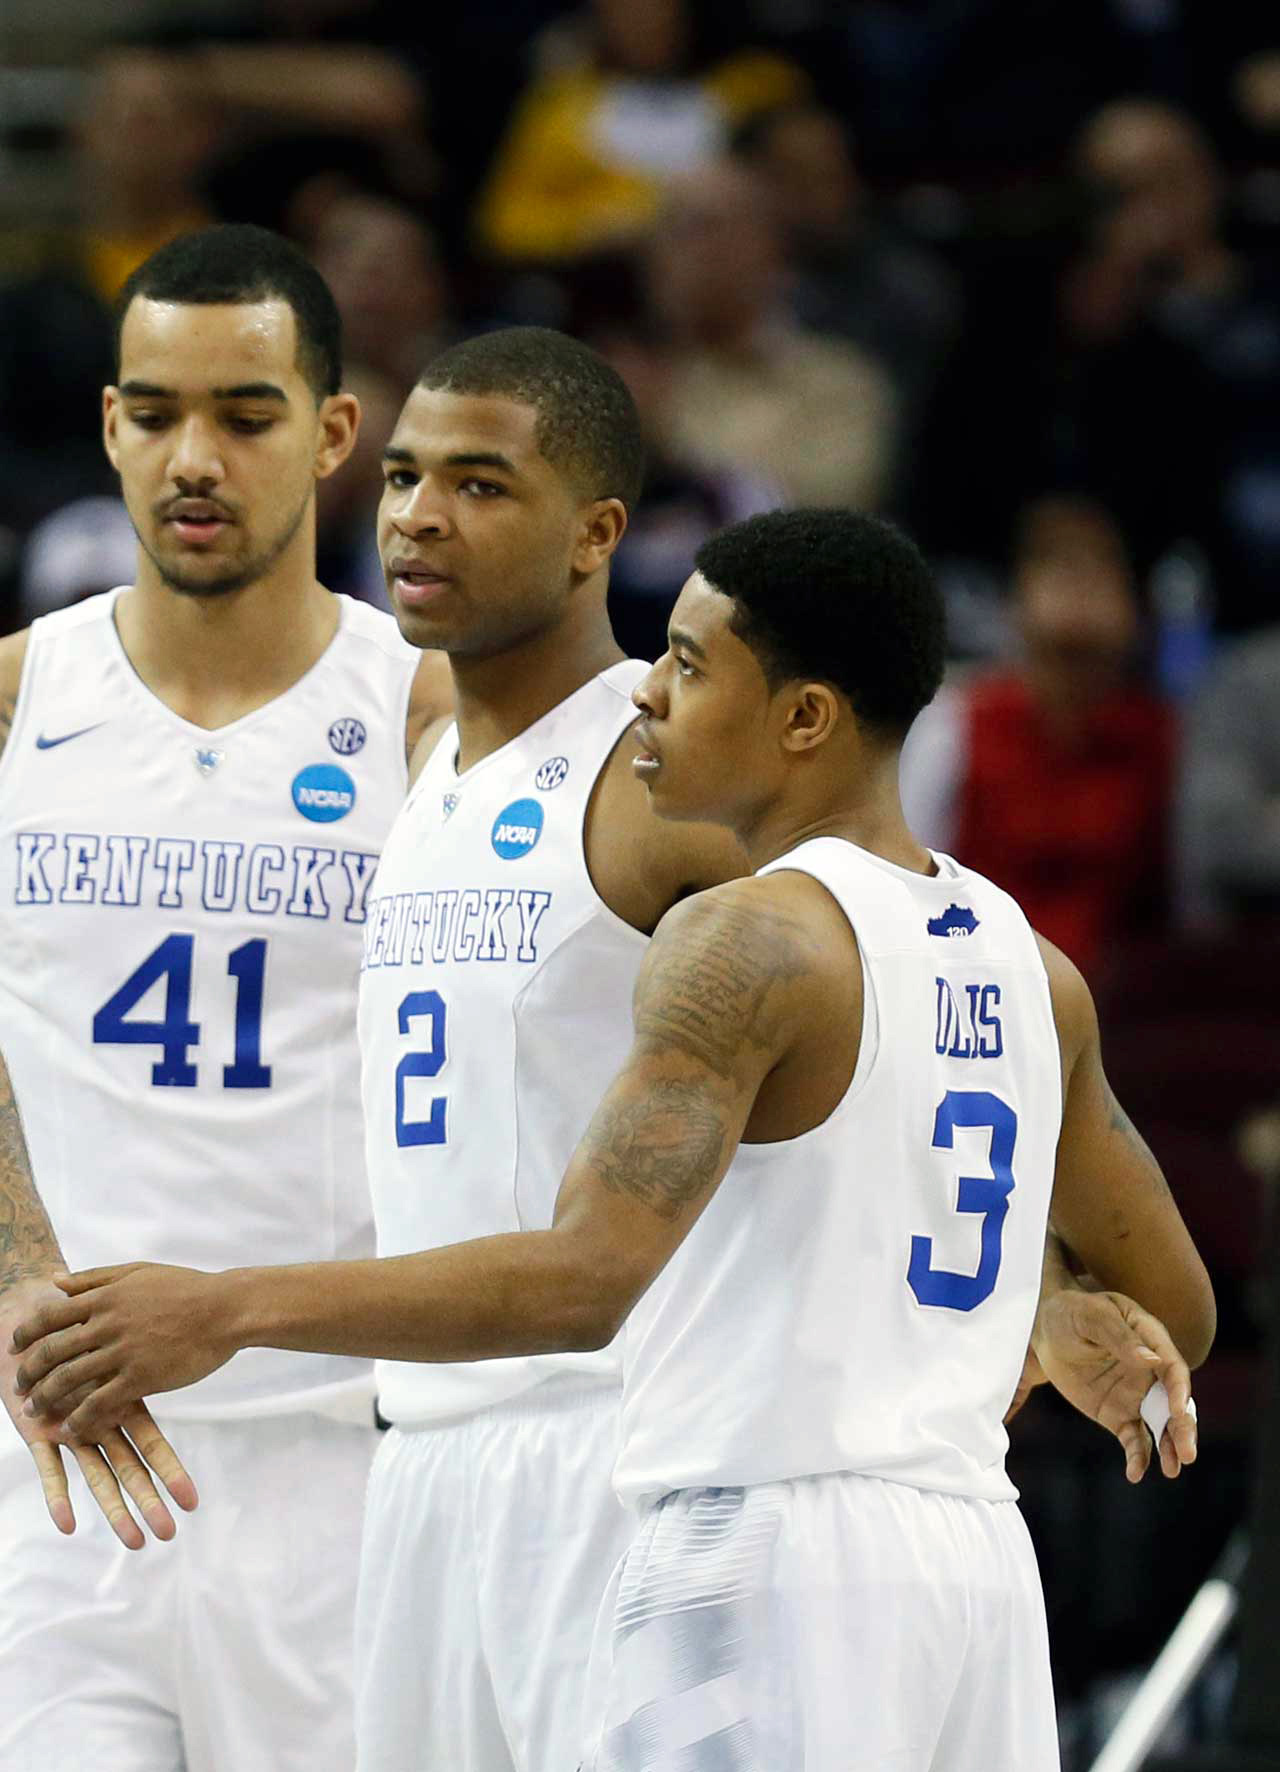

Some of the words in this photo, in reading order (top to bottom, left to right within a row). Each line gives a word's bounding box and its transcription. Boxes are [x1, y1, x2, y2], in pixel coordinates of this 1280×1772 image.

[298, 783, 352, 808] NCAA
[494, 823, 537, 846] NCAA
[15, 833, 380, 924] KENTUCKY
[360, 889, 552, 972] ENTUCKY
[93, 933, 272, 1089] 41
[396, 989, 448, 1148] 2
[907, 1090, 1017, 1312] 3
